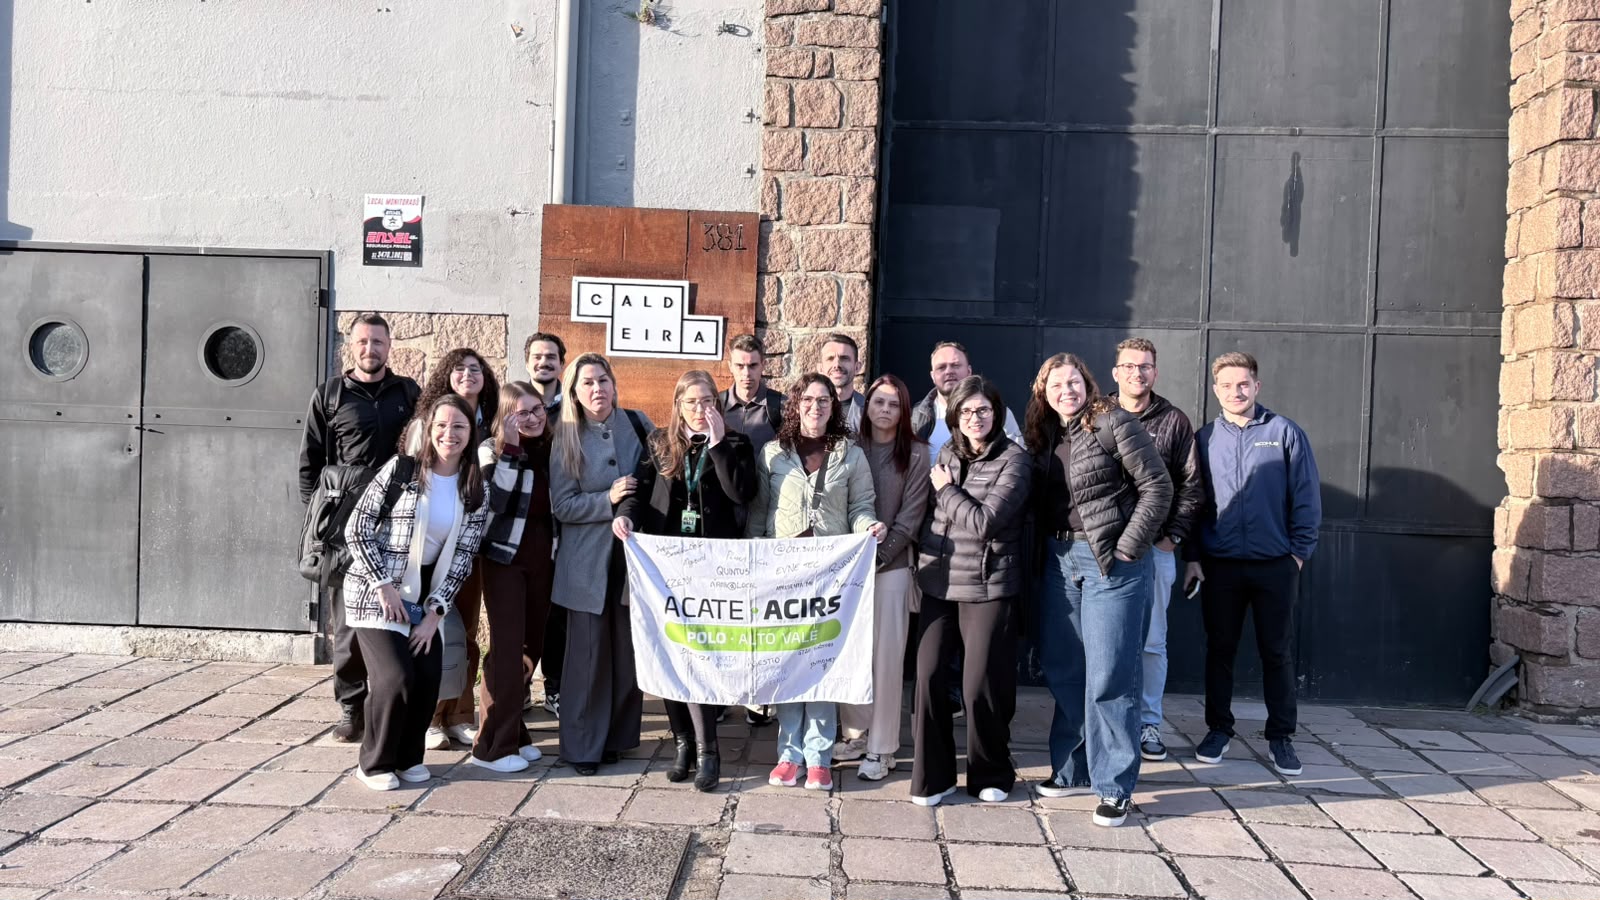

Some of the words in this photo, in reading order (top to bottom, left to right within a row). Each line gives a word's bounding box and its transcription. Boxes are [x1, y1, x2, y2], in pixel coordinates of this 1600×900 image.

[368, 197, 383, 205] LOCAL
[385, 197, 419, 206] MONITORADO
[702, 223, 747, 252] 381
[716, 566, 750, 576] QUINTUS
[664, 595, 744, 620] ACATE
[763, 594, 842, 620] ACIRS
[687, 631, 726, 644] POLO
[738, 632, 776, 646] ALTO
[782, 630, 818, 645] VALE
